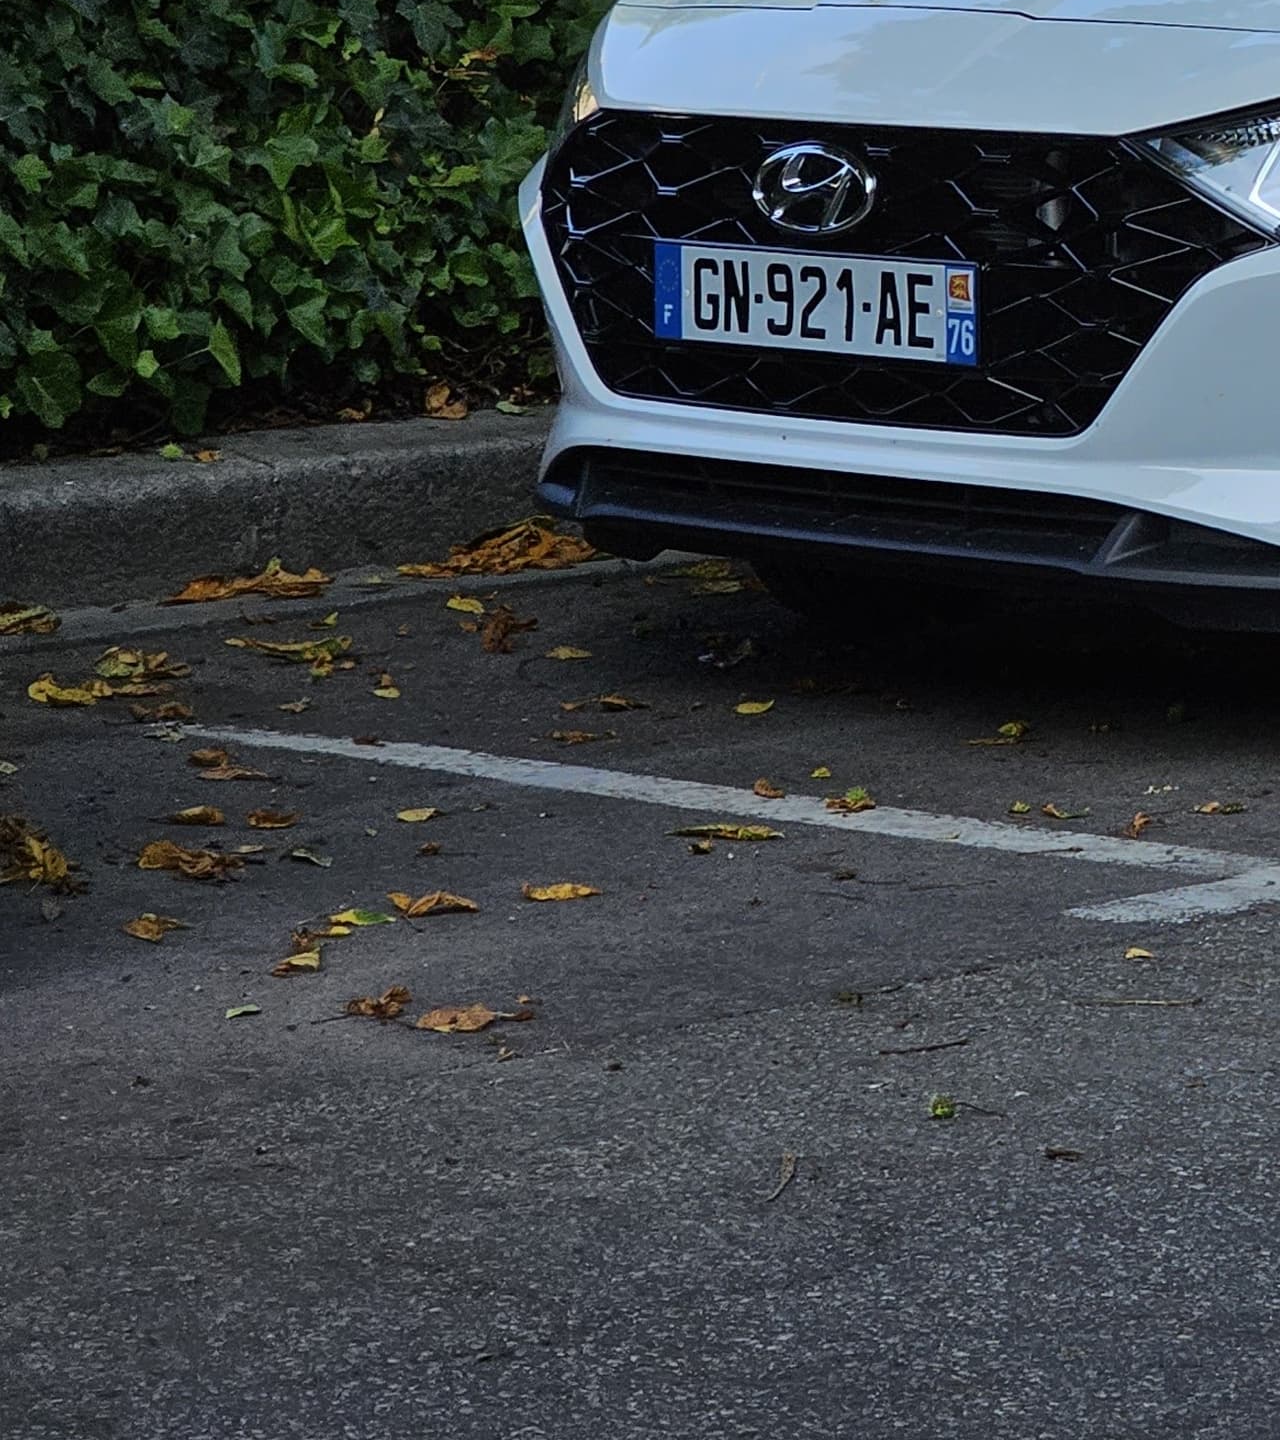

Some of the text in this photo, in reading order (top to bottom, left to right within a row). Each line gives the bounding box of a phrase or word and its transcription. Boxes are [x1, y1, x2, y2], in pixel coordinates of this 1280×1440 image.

[663, 303, 674, 325] F
[693, 256, 935, 350] GN-921-AE
[948, 318, 974, 357] 76
